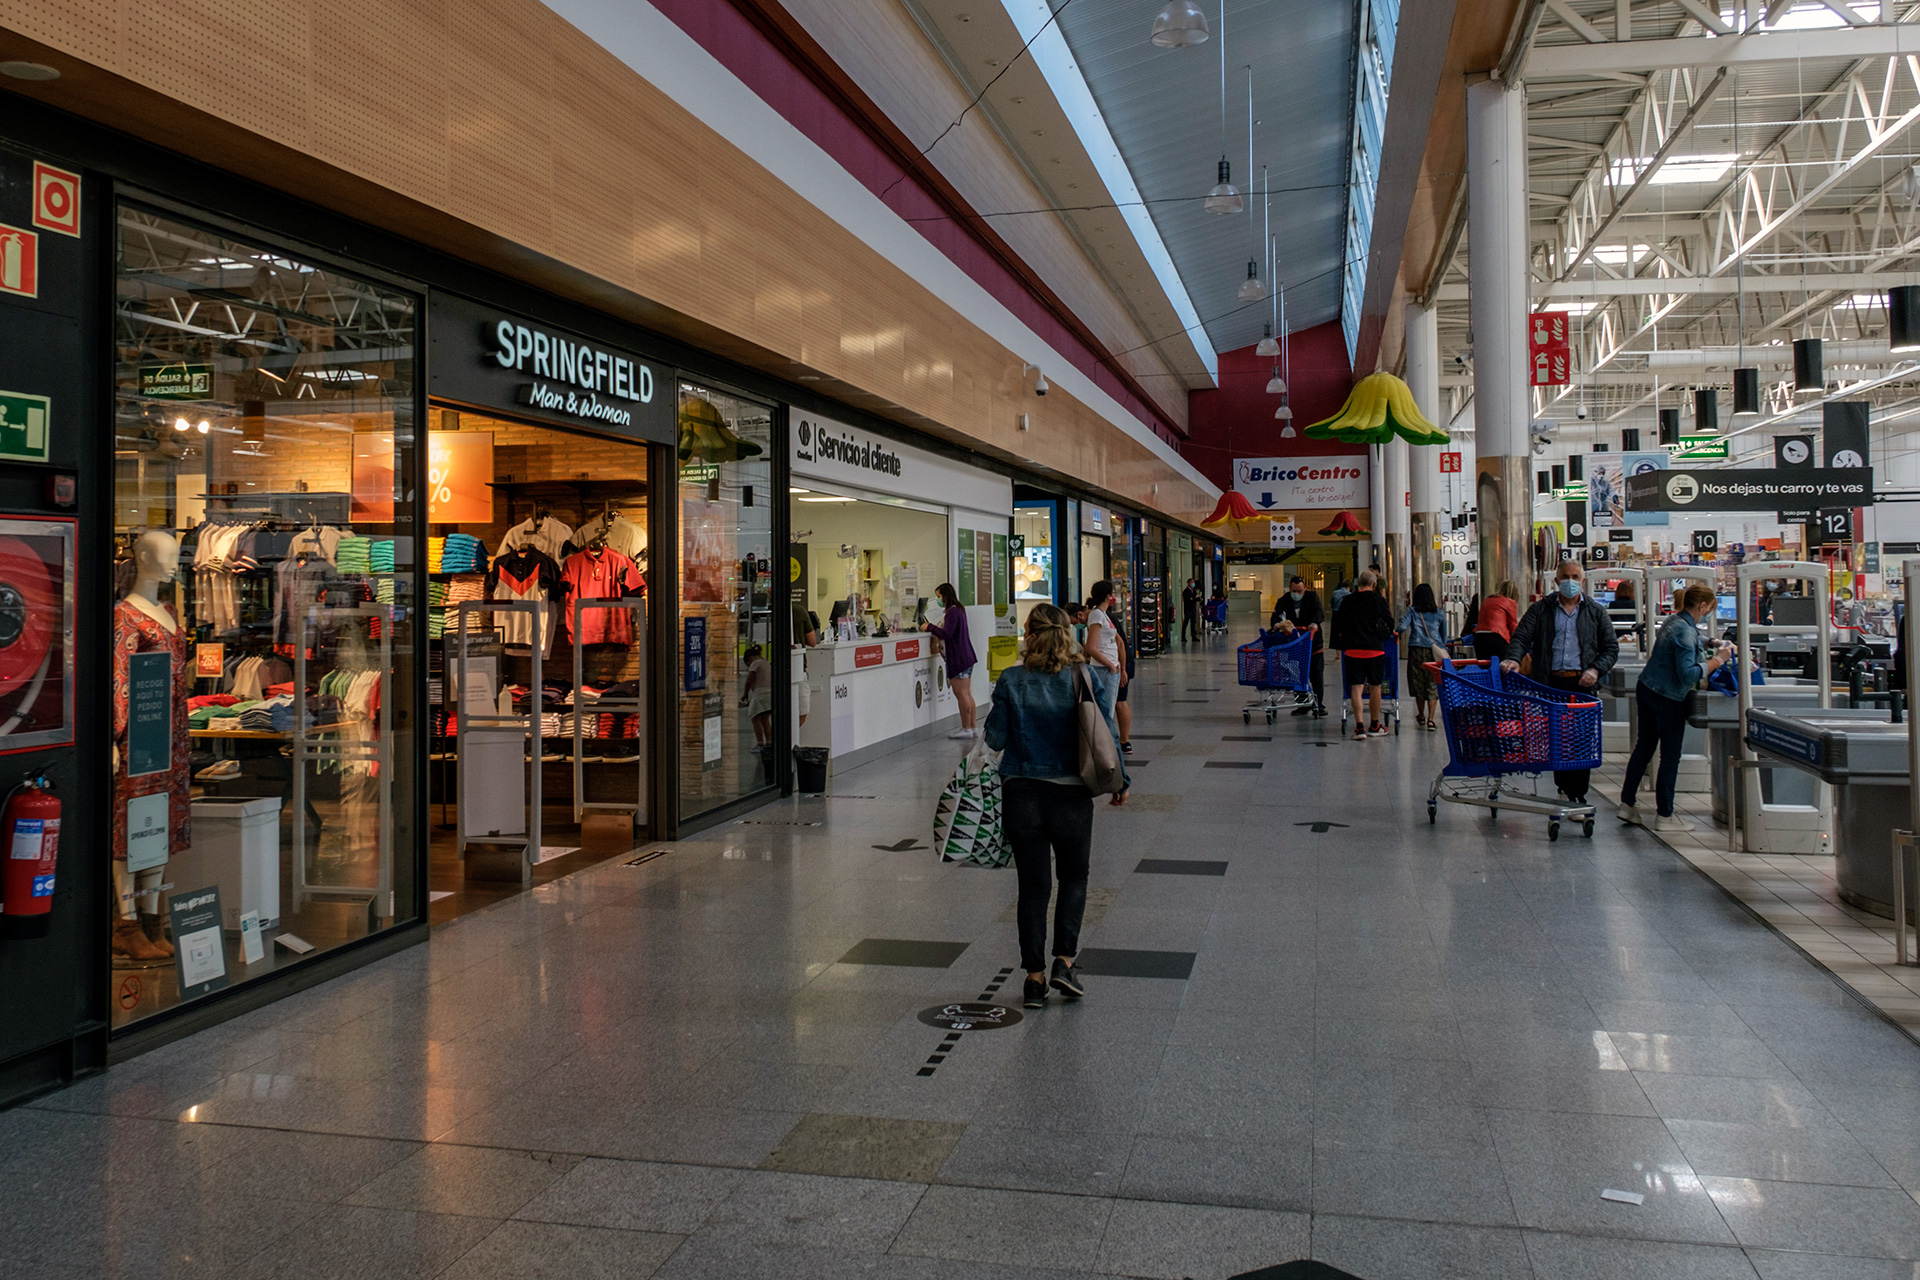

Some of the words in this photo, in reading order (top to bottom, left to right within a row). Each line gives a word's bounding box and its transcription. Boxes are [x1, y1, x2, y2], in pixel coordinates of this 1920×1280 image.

[496, 320, 653, 404] SPRINGFIELD
[530, 382, 563, 410] Man
[566, 391, 578, 415] &
[579, 393, 631, 426] Woman
[818, 427, 860, 467] Servicio
[861, 441, 870, 468] al
[871, 443, 901, 477] cliente
[1250, 466, 1361, 482] BricoCentro
[1308, 486, 1334, 495] centro
[1702, 484, 1727, 493] Nos
[1729, 483, 1763, 496] dejas
[1764, 483, 1778, 493] tu
[1780, 485, 1815, 493] carro
[1816, 485, 1824, 496] y
[1825, 483, 1840, 493] te
[1841, 485, 1864, 493] vas
[1306, 495, 1315, 503] de
[1825, 514, 1846, 533] 12
[1696, 534, 1715, 548] 10
[1562, 551, 1569, 560] 8
[1595, 548, 1604, 559] 9
[136, 679, 164, 689] RECOGE
[136, 690, 153, 701] AQUÍ
[155, 690, 164, 699] TU
[835, 683, 848, 700] Hola
[137, 701, 163, 711] PEDIDO
[137, 712, 163, 723] ONLINE
